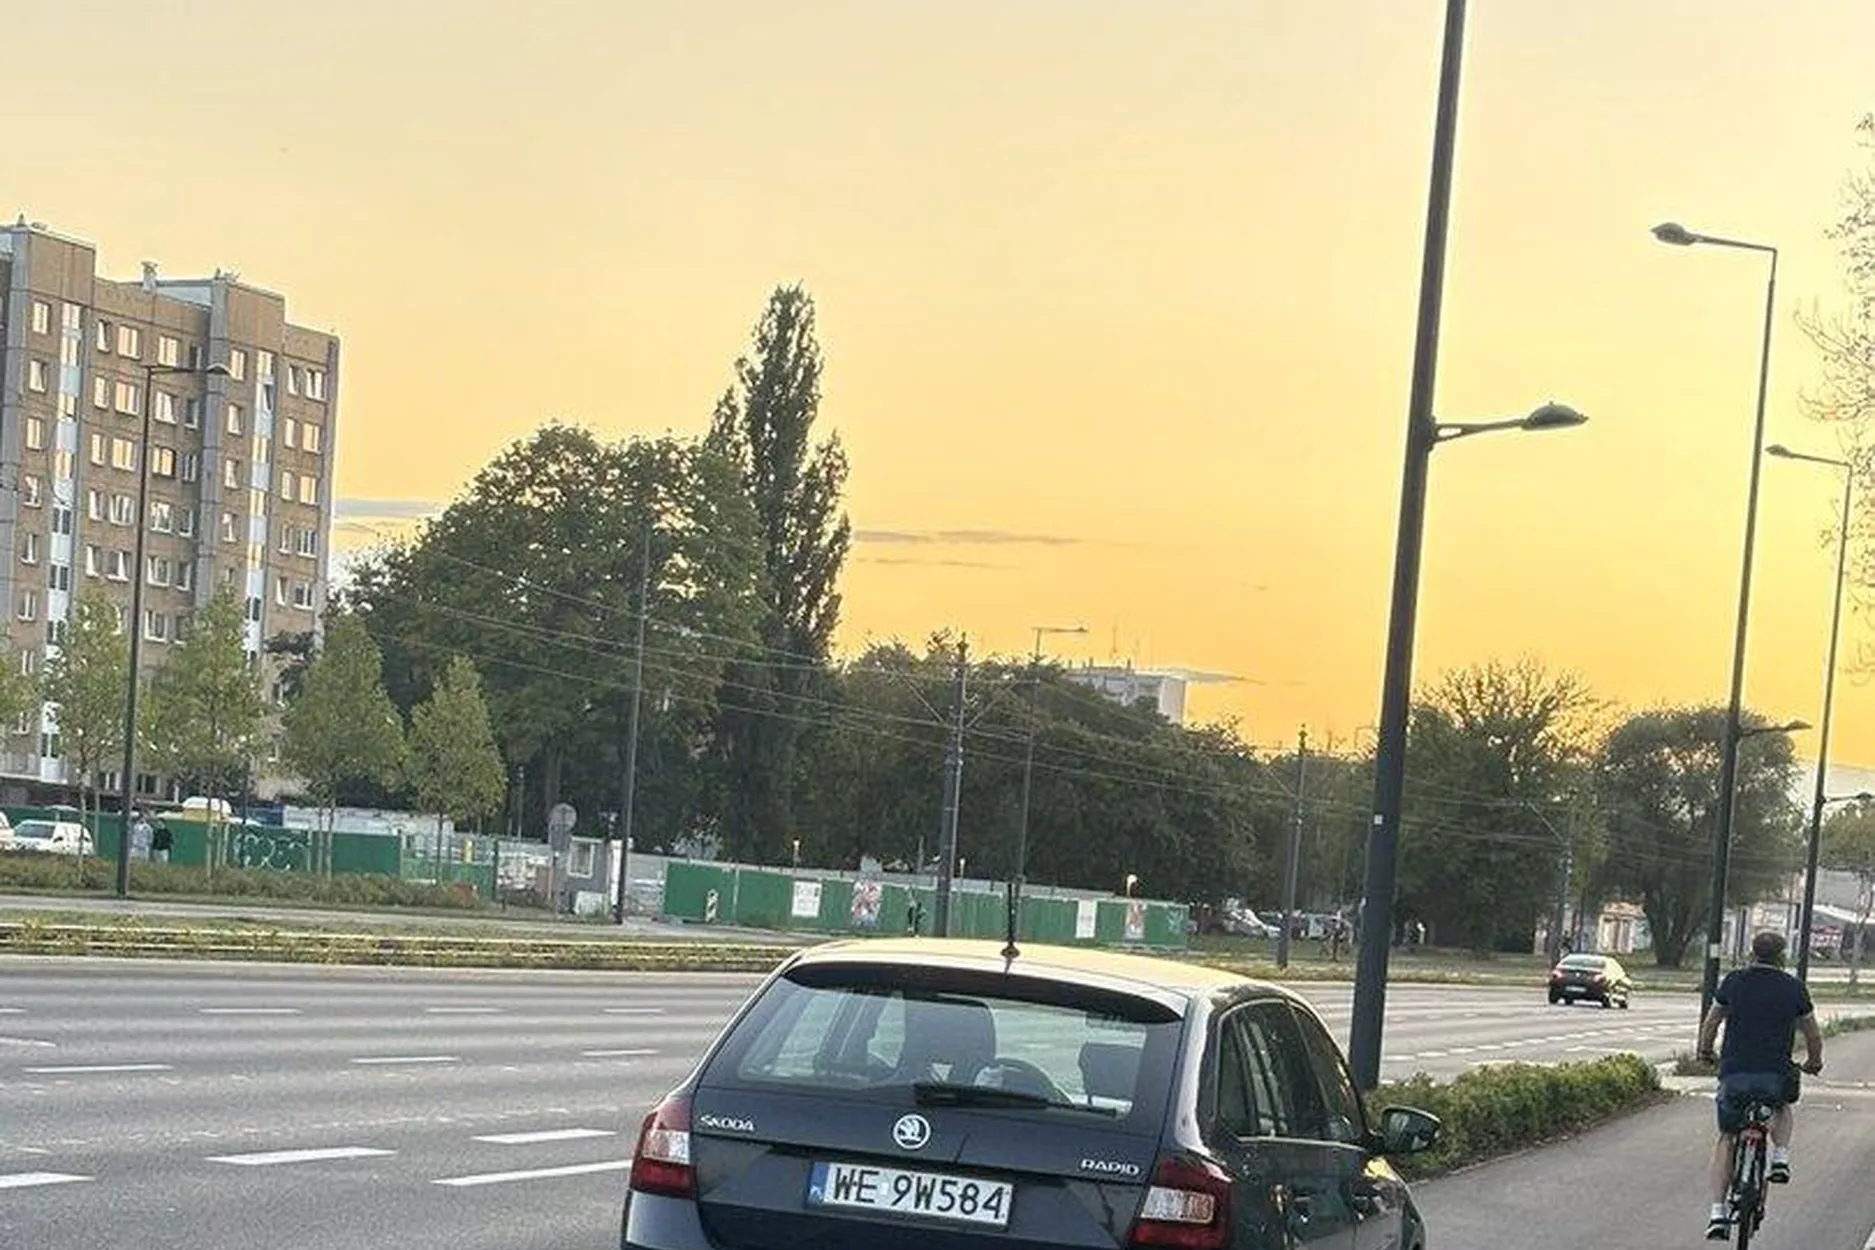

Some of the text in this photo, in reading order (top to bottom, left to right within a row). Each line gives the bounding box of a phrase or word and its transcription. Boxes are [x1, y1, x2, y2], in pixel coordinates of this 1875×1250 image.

[1081, 1159, 1140, 1176] RAPID
[834, 1167, 880, 1204] WE
[890, 1173, 1005, 1219] 9W584
